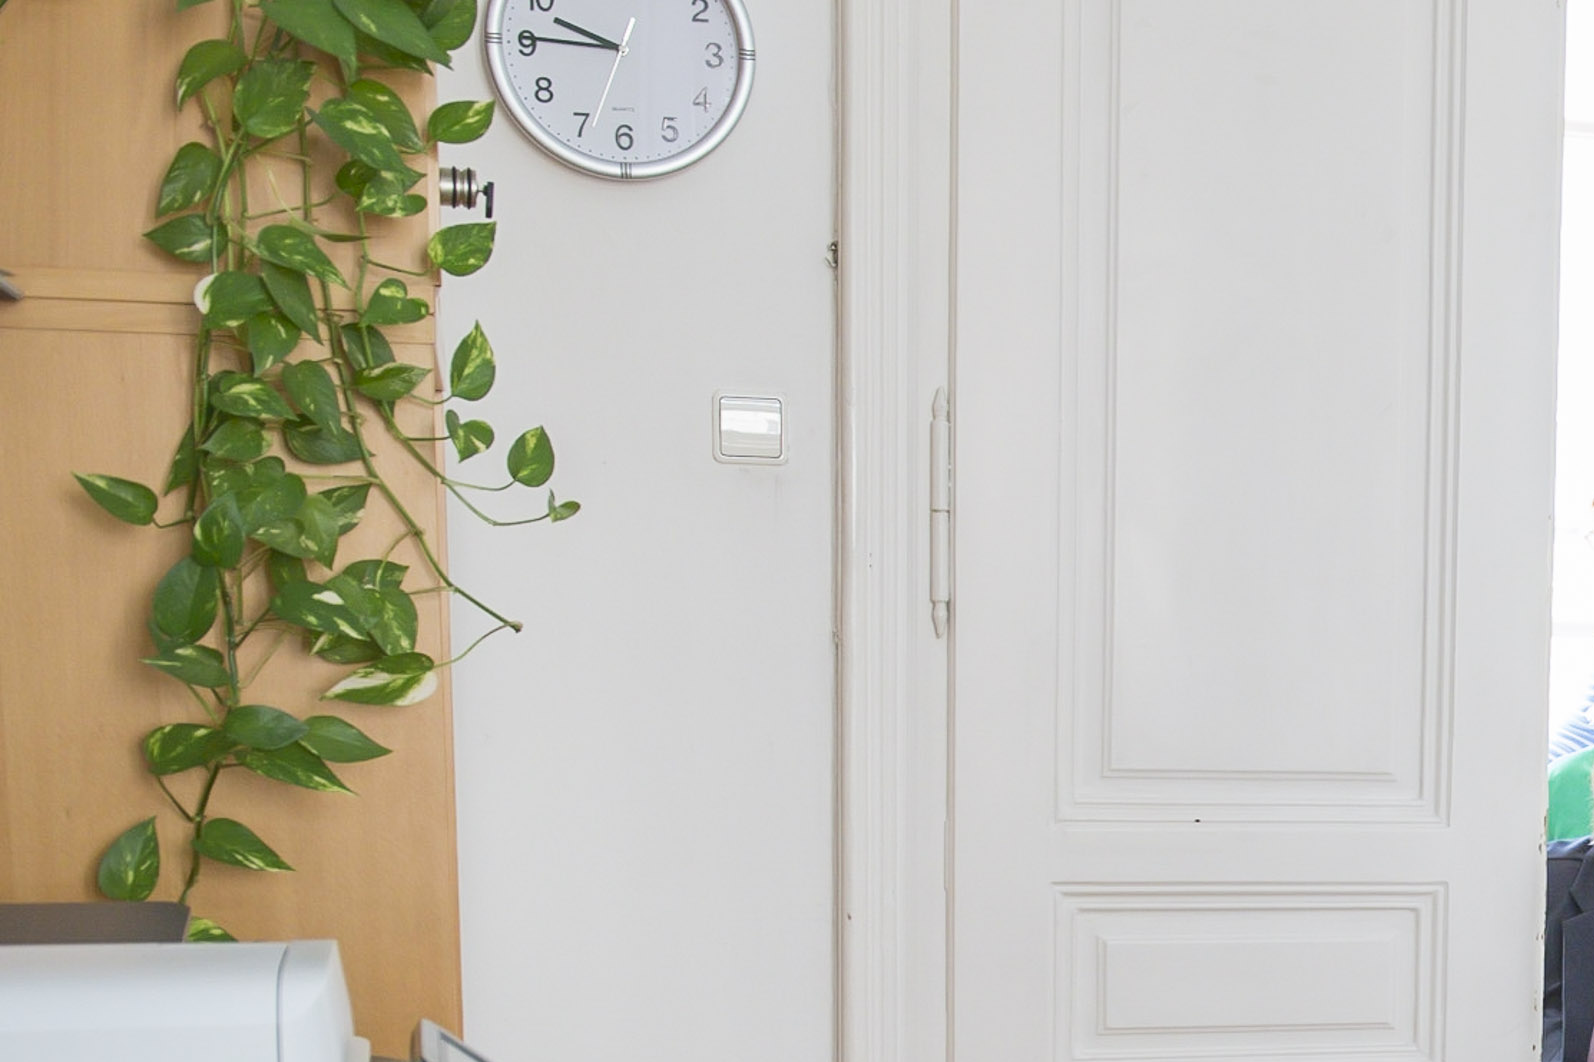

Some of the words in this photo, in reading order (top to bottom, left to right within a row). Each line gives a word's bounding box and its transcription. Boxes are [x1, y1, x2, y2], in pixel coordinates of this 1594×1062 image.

[691, 0, 709, 23] 2
[518, 30, 536, 56] 9
[705, 42, 724, 69] 3
[534, 77, 554, 103] 8
[692, 87, 712, 113] 4
[573, 112, 590, 138] 7
[615, 124, 634, 151] 6
[661, 117, 680, 143] 5
